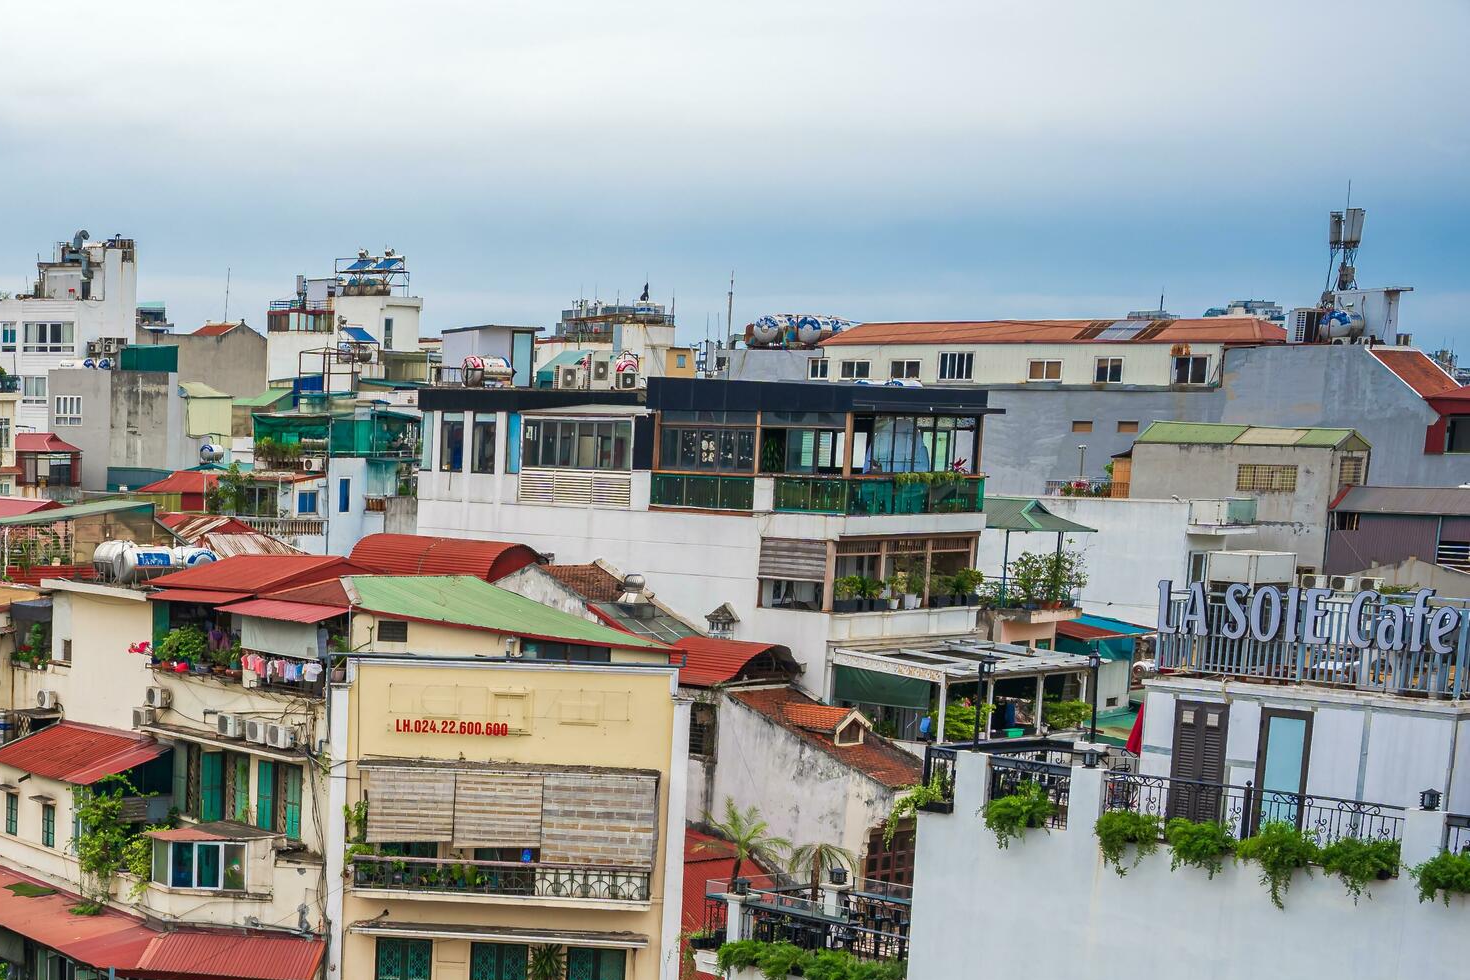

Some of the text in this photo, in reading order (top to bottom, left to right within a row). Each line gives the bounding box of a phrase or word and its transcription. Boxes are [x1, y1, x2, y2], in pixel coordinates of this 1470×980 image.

[1157, 579, 1462, 654] LA SOIE Cafe
[395, 719, 508, 736] LH.024.22.600.600
